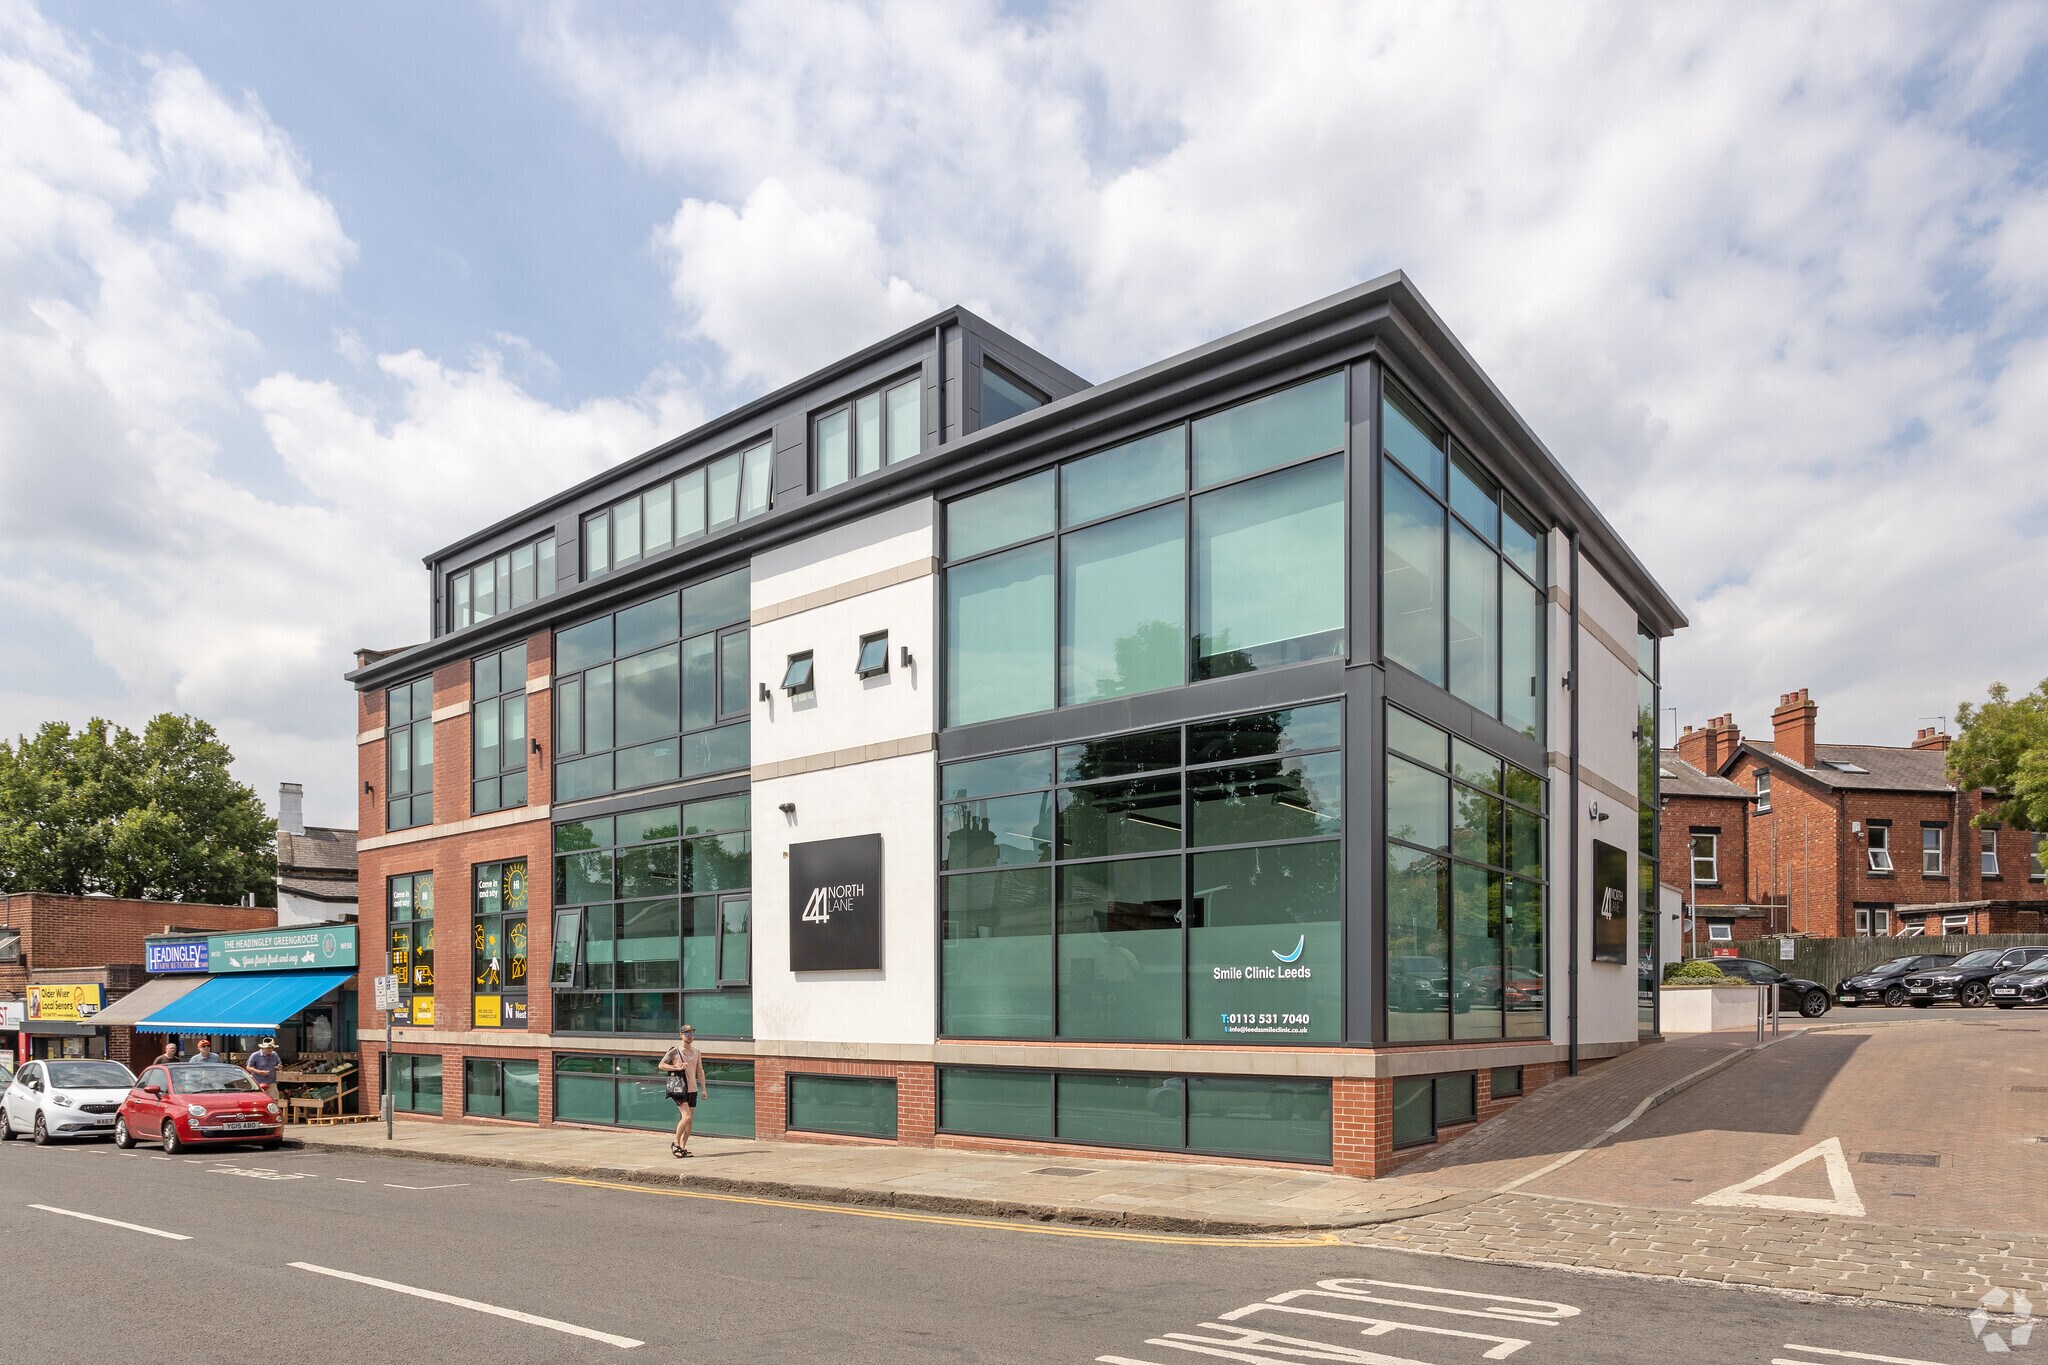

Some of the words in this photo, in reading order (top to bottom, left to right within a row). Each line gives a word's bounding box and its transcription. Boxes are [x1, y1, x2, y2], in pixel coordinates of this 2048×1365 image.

[513, 880, 520, 889] Hi
[422, 892, 428, 900] Hi
[489, 890, 498, 898] say
[828, 884, 864, 899] NORTH
[828, 898, 854, 913] LANE
[224, 940, 235, 949] THE
[235, 937, 273, 948] HEADINGLEY
[273, 934, 319, 946] GREENGROCER
[149, 945, 201, 970] HEADINGLEY
[279, 953, 289, 963] and
[1213, 967, 1242, 980] Smile
[1244, 966, 1276, 979] Clinic
[1278, 965, 1311, 979] Leeds
[41, 1000, 54, 1010] Local
[515, 1002, 527, 1011] Your
[515, 1010, 527, 1019] Nest
[1258, 1013, 1278, 1024] 531
[1282, 1013, 1310, 1024] 7040
